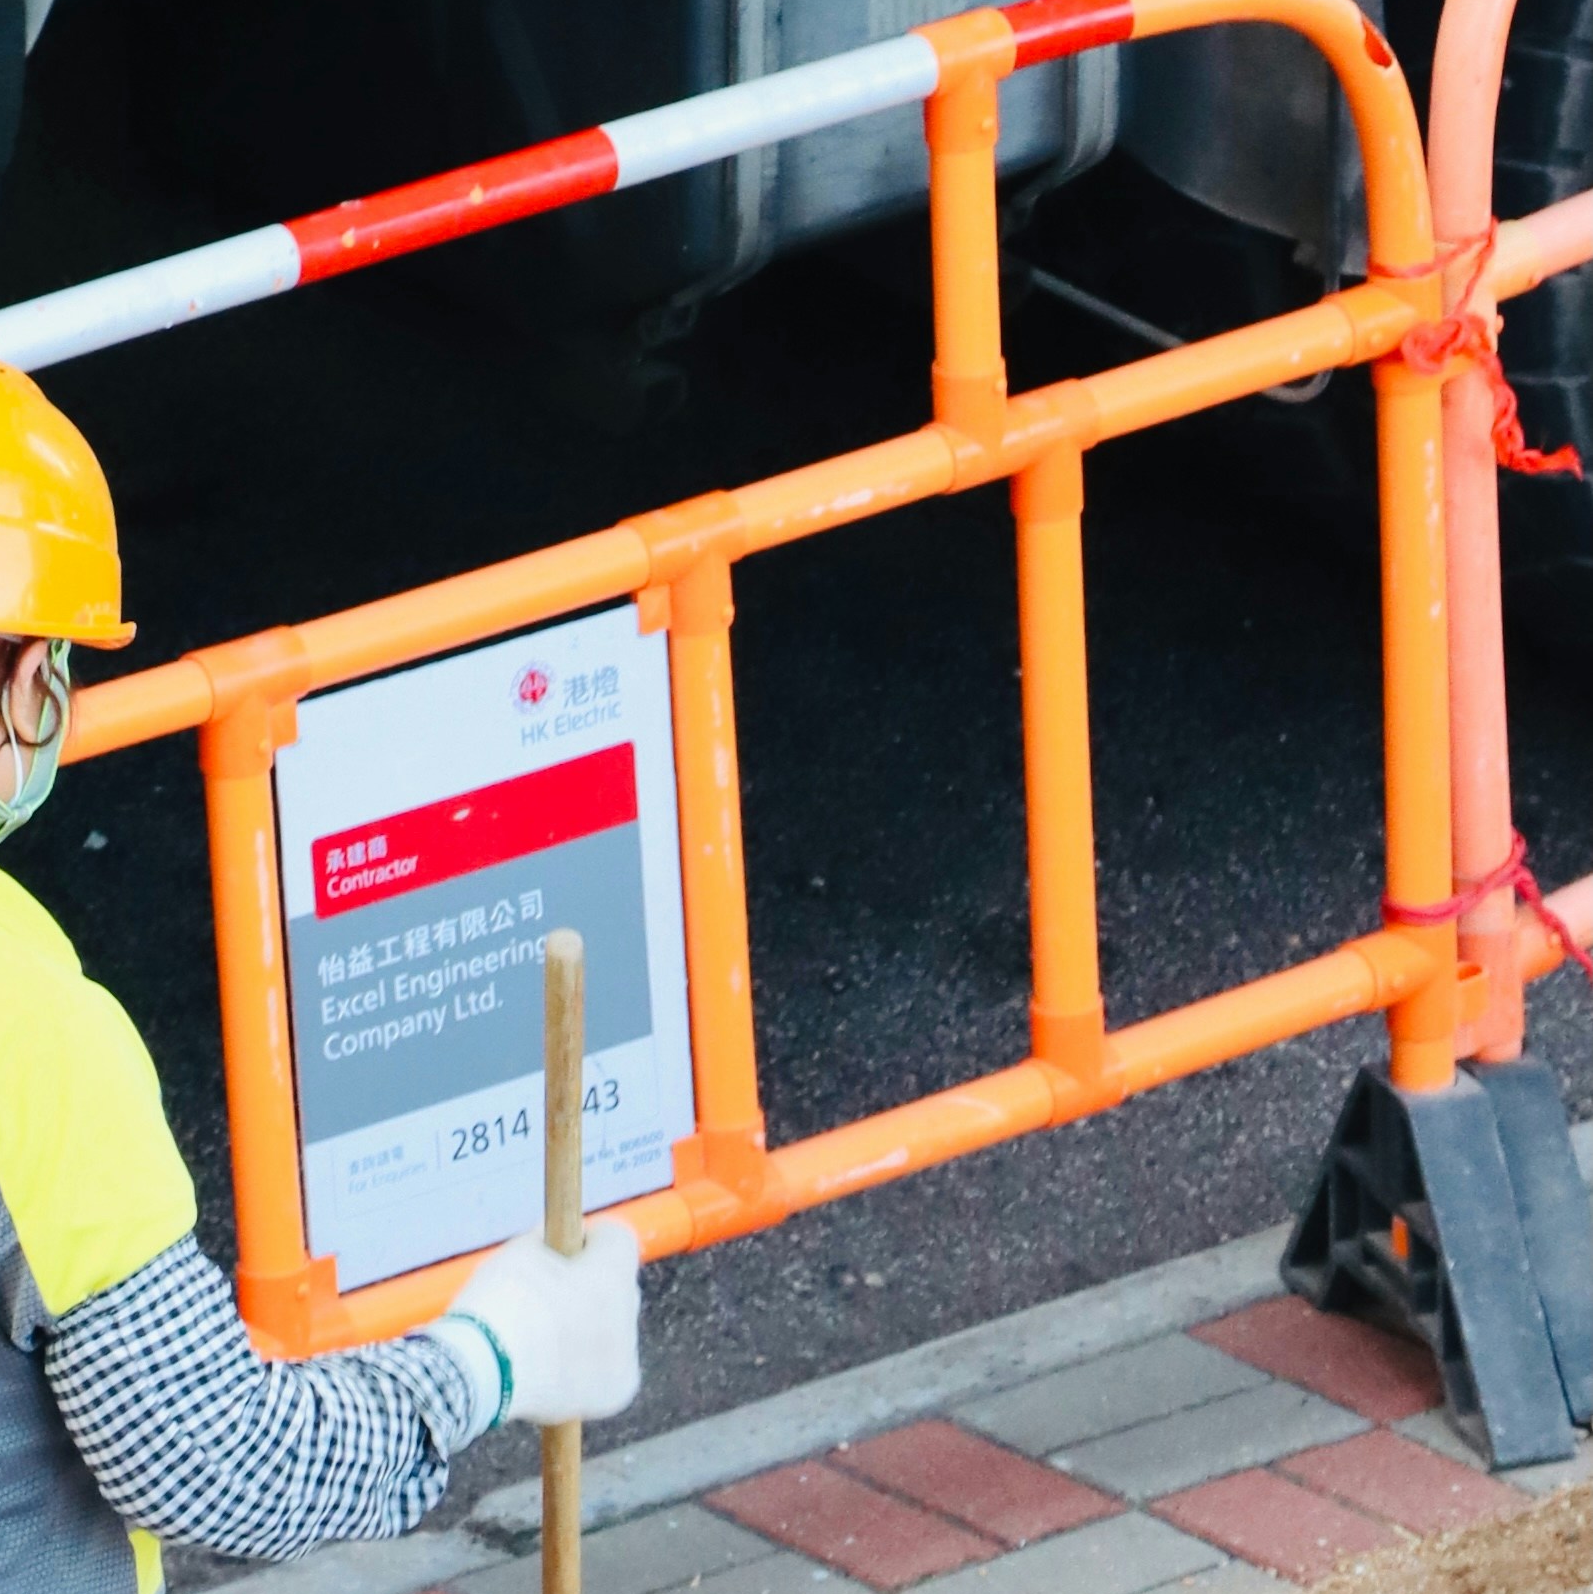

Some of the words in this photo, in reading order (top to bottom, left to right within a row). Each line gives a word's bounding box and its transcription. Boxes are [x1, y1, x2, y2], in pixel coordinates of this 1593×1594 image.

[521, 720, 549, 747] HK
[554, 700, 621, 736] Electric
[327, 855, 418, 899] Contractor
[318, 888, 543, 987] 怡益工程有限公司
[321, 979, 386, 1025] Excel
[394, 934, 548, 1001] Engineering
[323, 1005, 447, 1061] Company
[454, 981, 504, 1021] Ltd.
[451, 1109, 533, 1161] 2814
